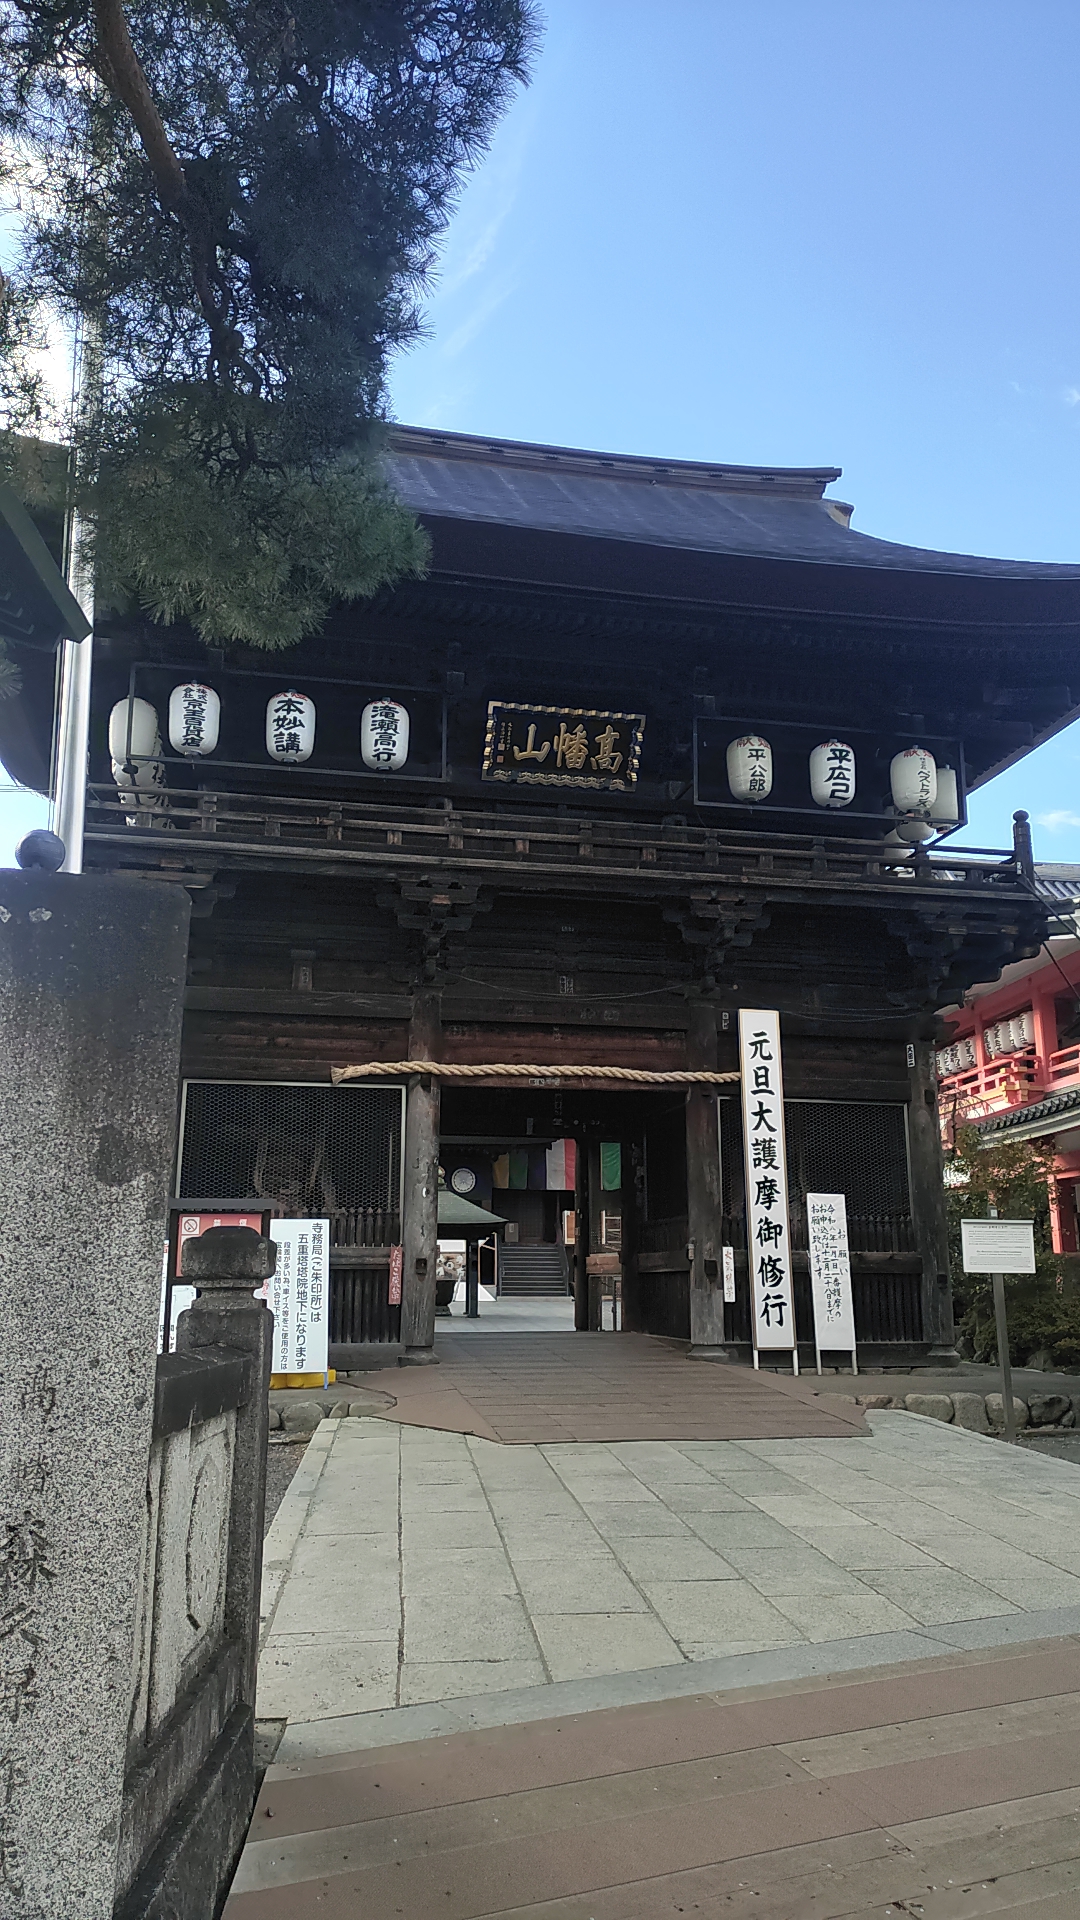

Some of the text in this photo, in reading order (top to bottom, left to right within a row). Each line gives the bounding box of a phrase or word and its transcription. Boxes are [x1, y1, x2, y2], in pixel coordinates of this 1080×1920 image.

[181, 698, 207, 748] 京王百貨店
[272, 697, 305, 754] 本妙講
[370, 705, 400, 762] 滝瀬高行
[747, 748, 768, 793] 平公郎
[747, 1030, 788, 1328] 元旦大護摩御修行
[294, 1233, 310, 1370] 五重塔塔院地下になります
